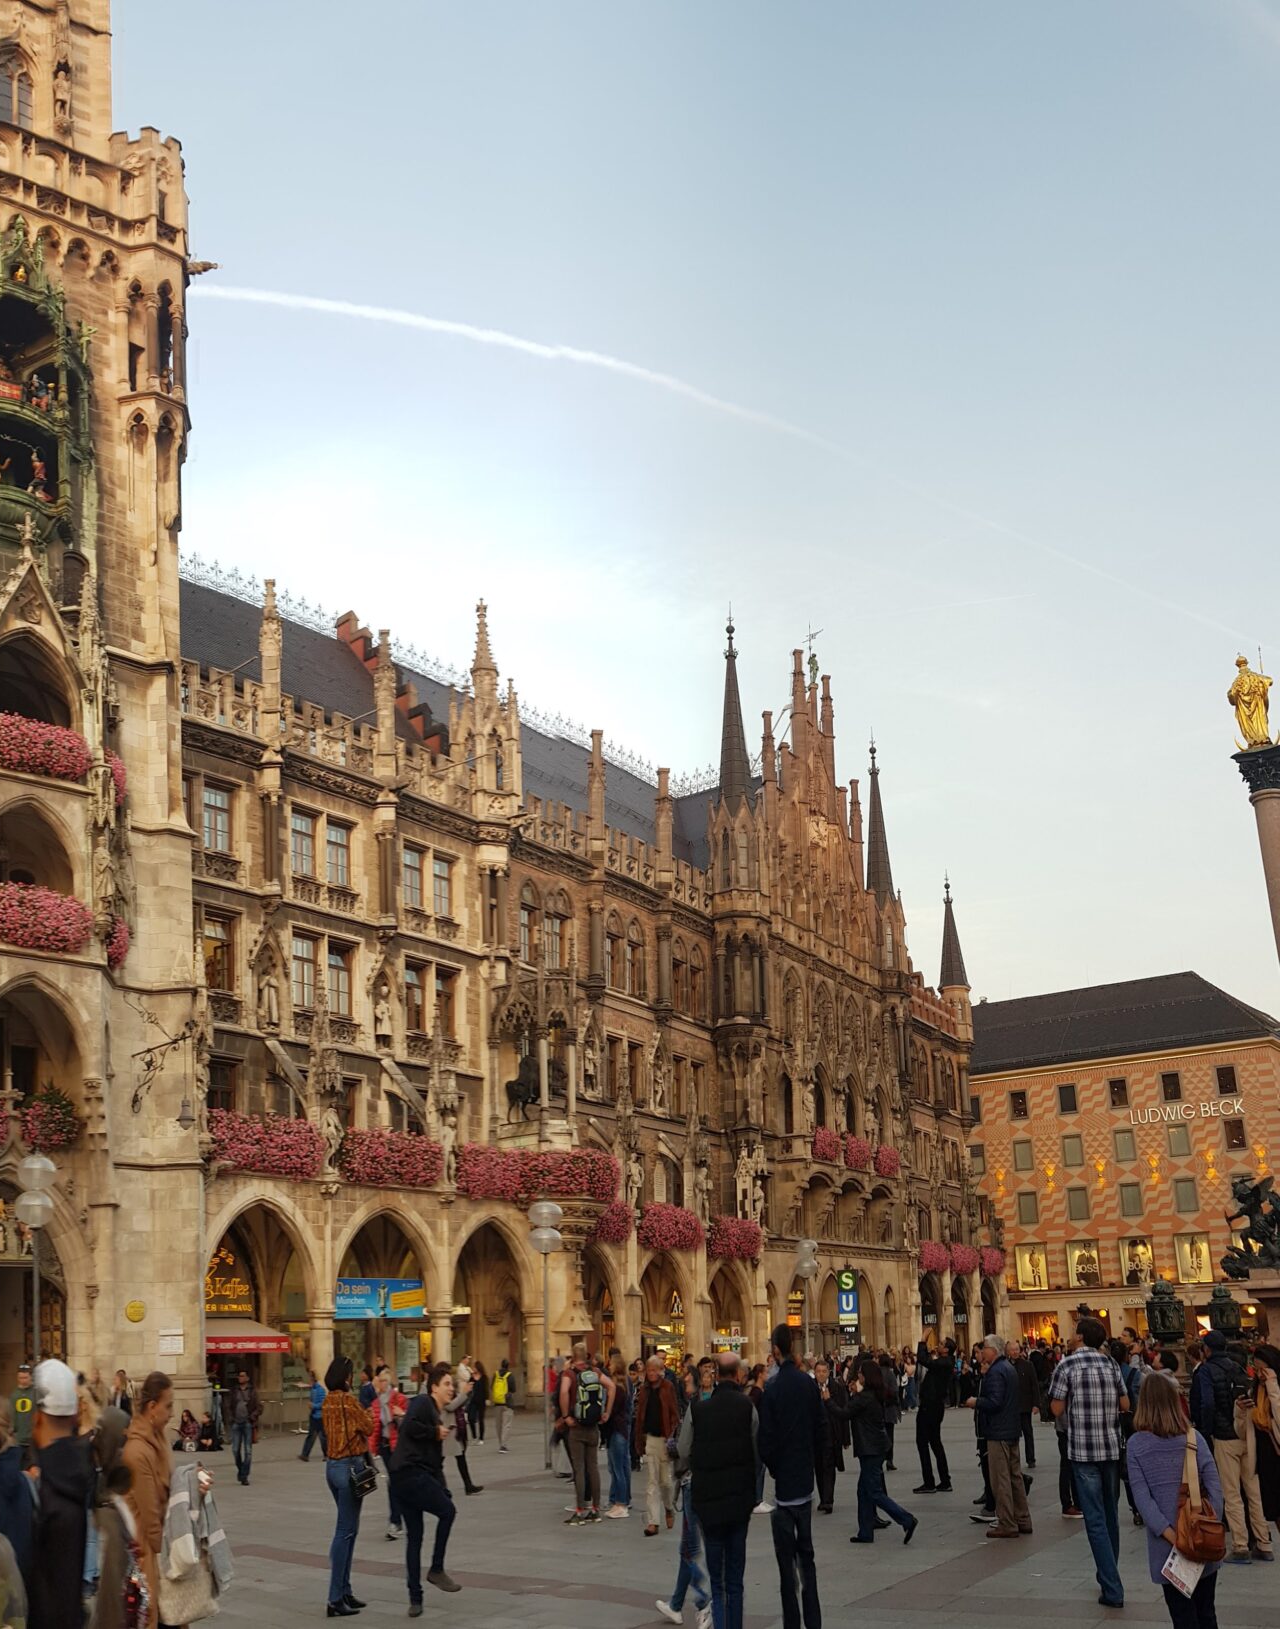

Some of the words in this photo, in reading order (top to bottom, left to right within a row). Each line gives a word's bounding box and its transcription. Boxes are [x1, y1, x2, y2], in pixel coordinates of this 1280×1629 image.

[1129, 1104, 1196, 1125] LUDWIG
[1200, 1098, 1245, 1117] BECK
[1076, 1264, 1099, 1274] BOSS
[1128, 1260, 1153, 1271] BOSS
[336, 1281, 350, 1295] Da
[841, 1272, 854, 1290] S
[841, 1294, 854, 1312] U
